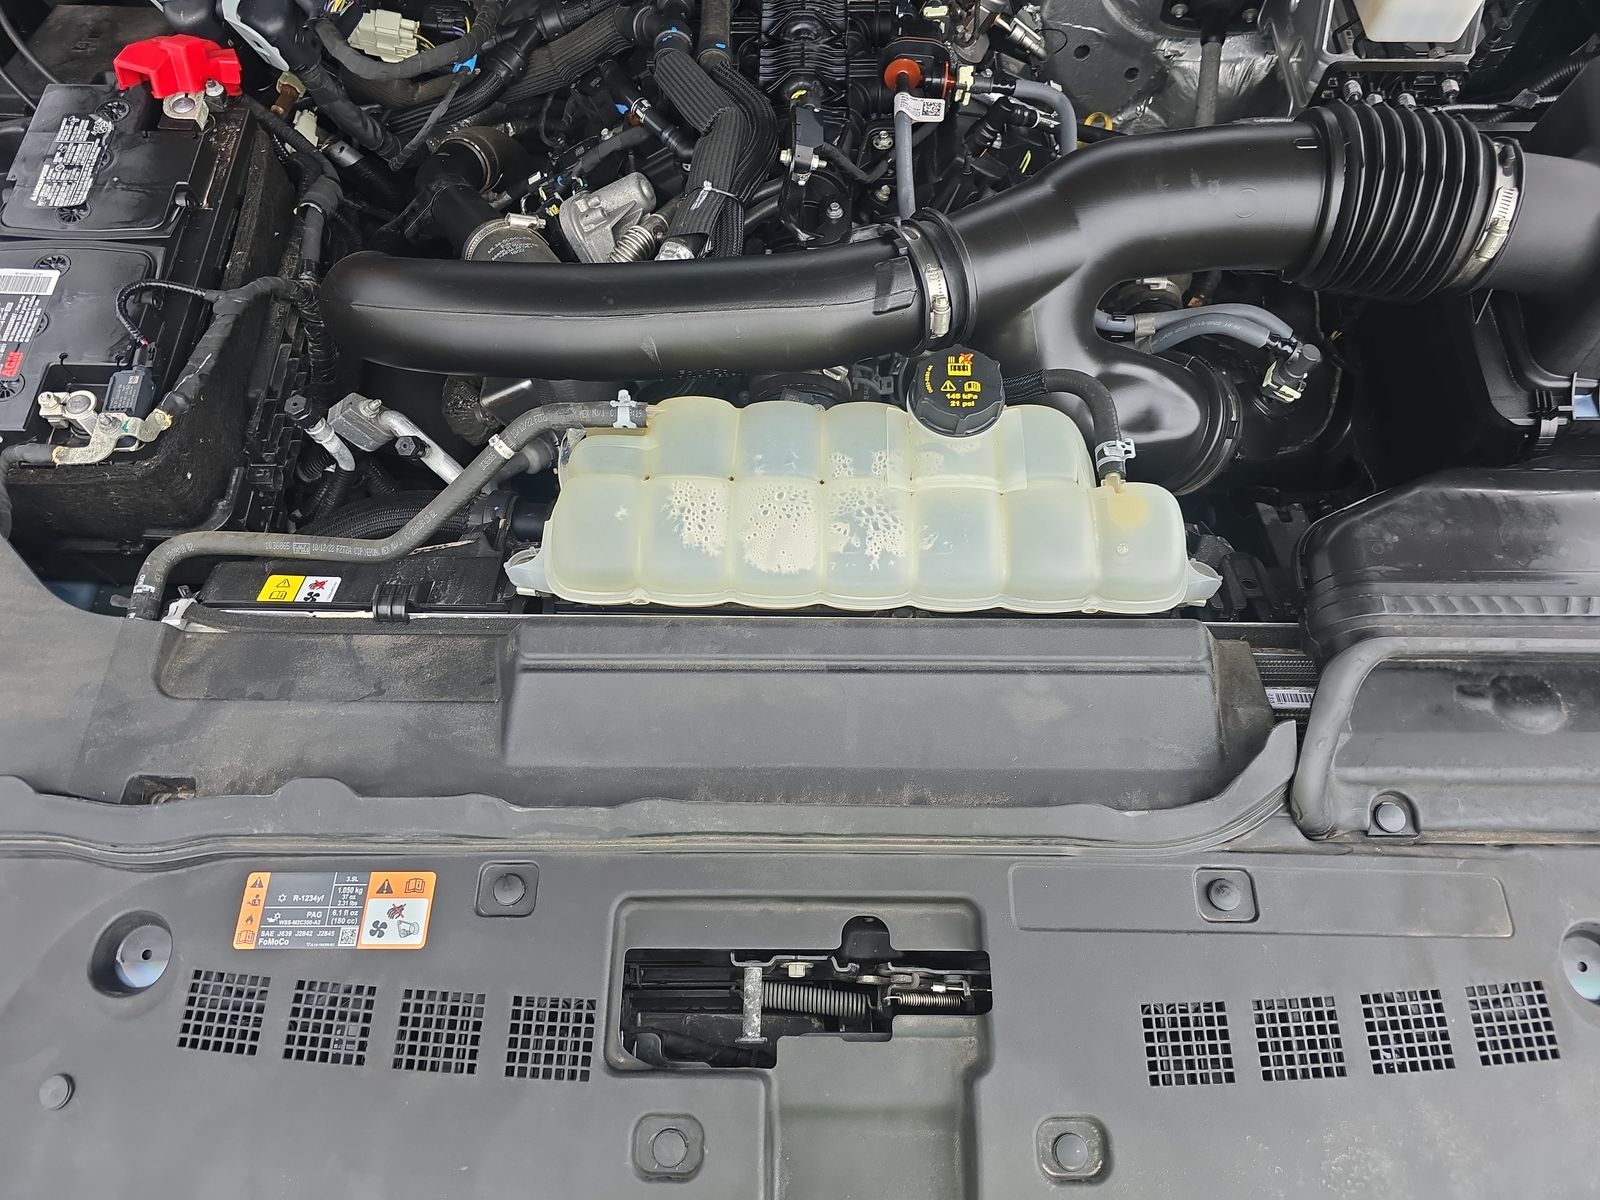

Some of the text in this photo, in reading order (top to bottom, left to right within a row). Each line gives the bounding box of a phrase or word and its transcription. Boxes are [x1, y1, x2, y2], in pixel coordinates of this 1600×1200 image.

[0, 352, 20, 377] AGM
[355, 887, 364, 895] kg
[293, 894, 325, 903] R-1234yf
[258, 938, 289, 946] FoMoCo
